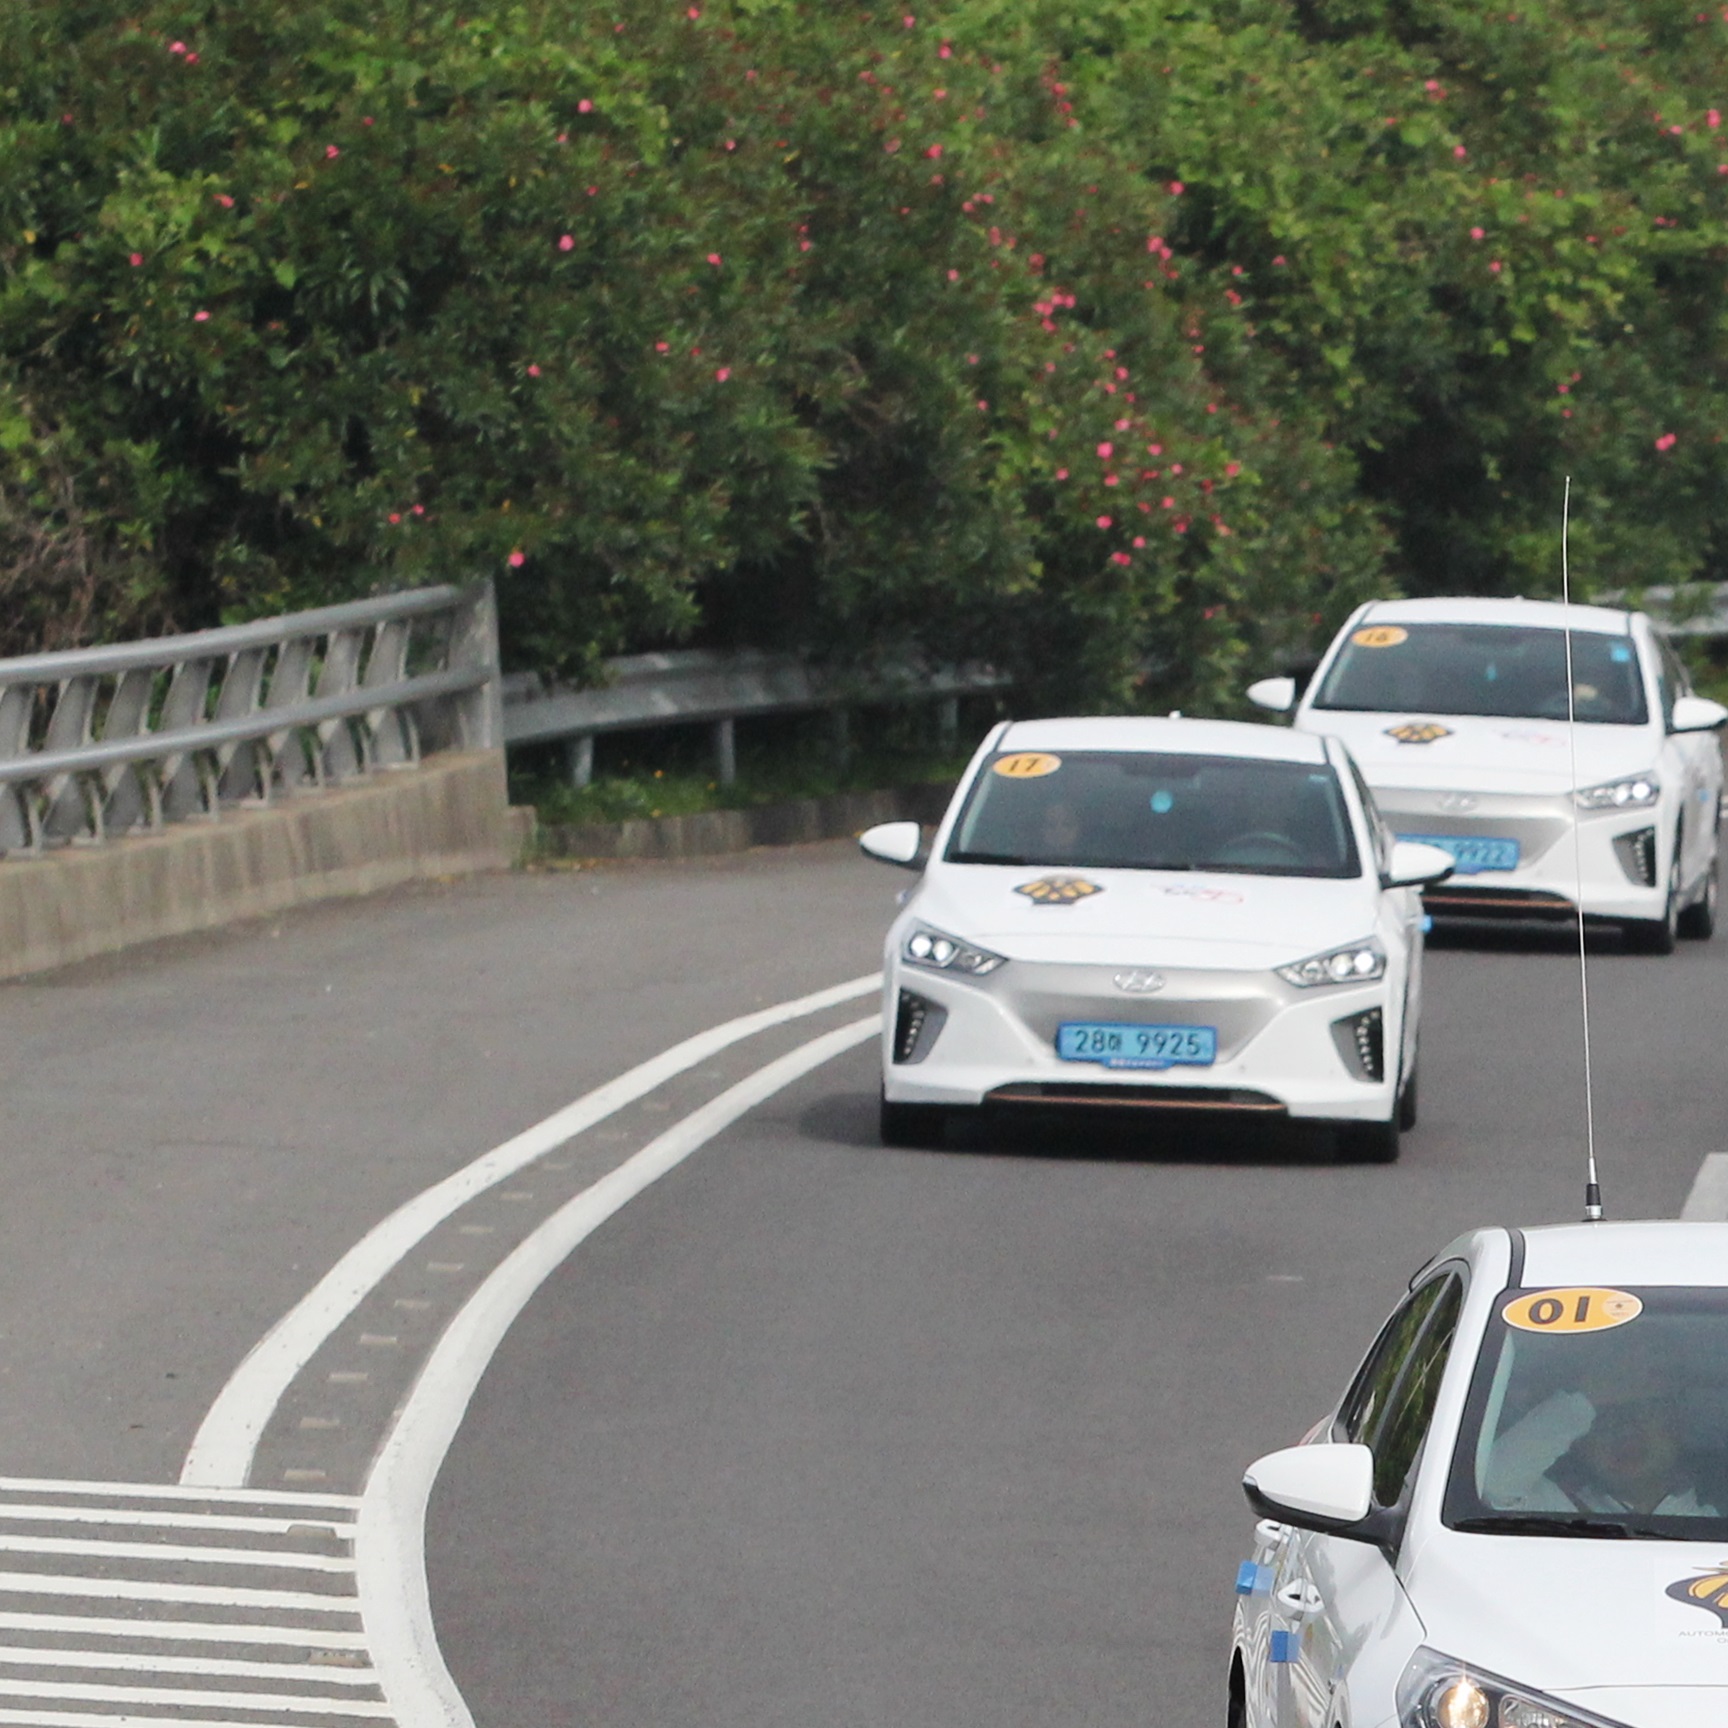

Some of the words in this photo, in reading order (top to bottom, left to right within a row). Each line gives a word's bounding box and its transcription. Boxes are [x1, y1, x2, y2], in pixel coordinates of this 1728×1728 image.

[1008, 757, 1041, 773] 17
[1137, 1031, 1200, 1057] 9925
[1528, 1296, 1590, 1325] 01
